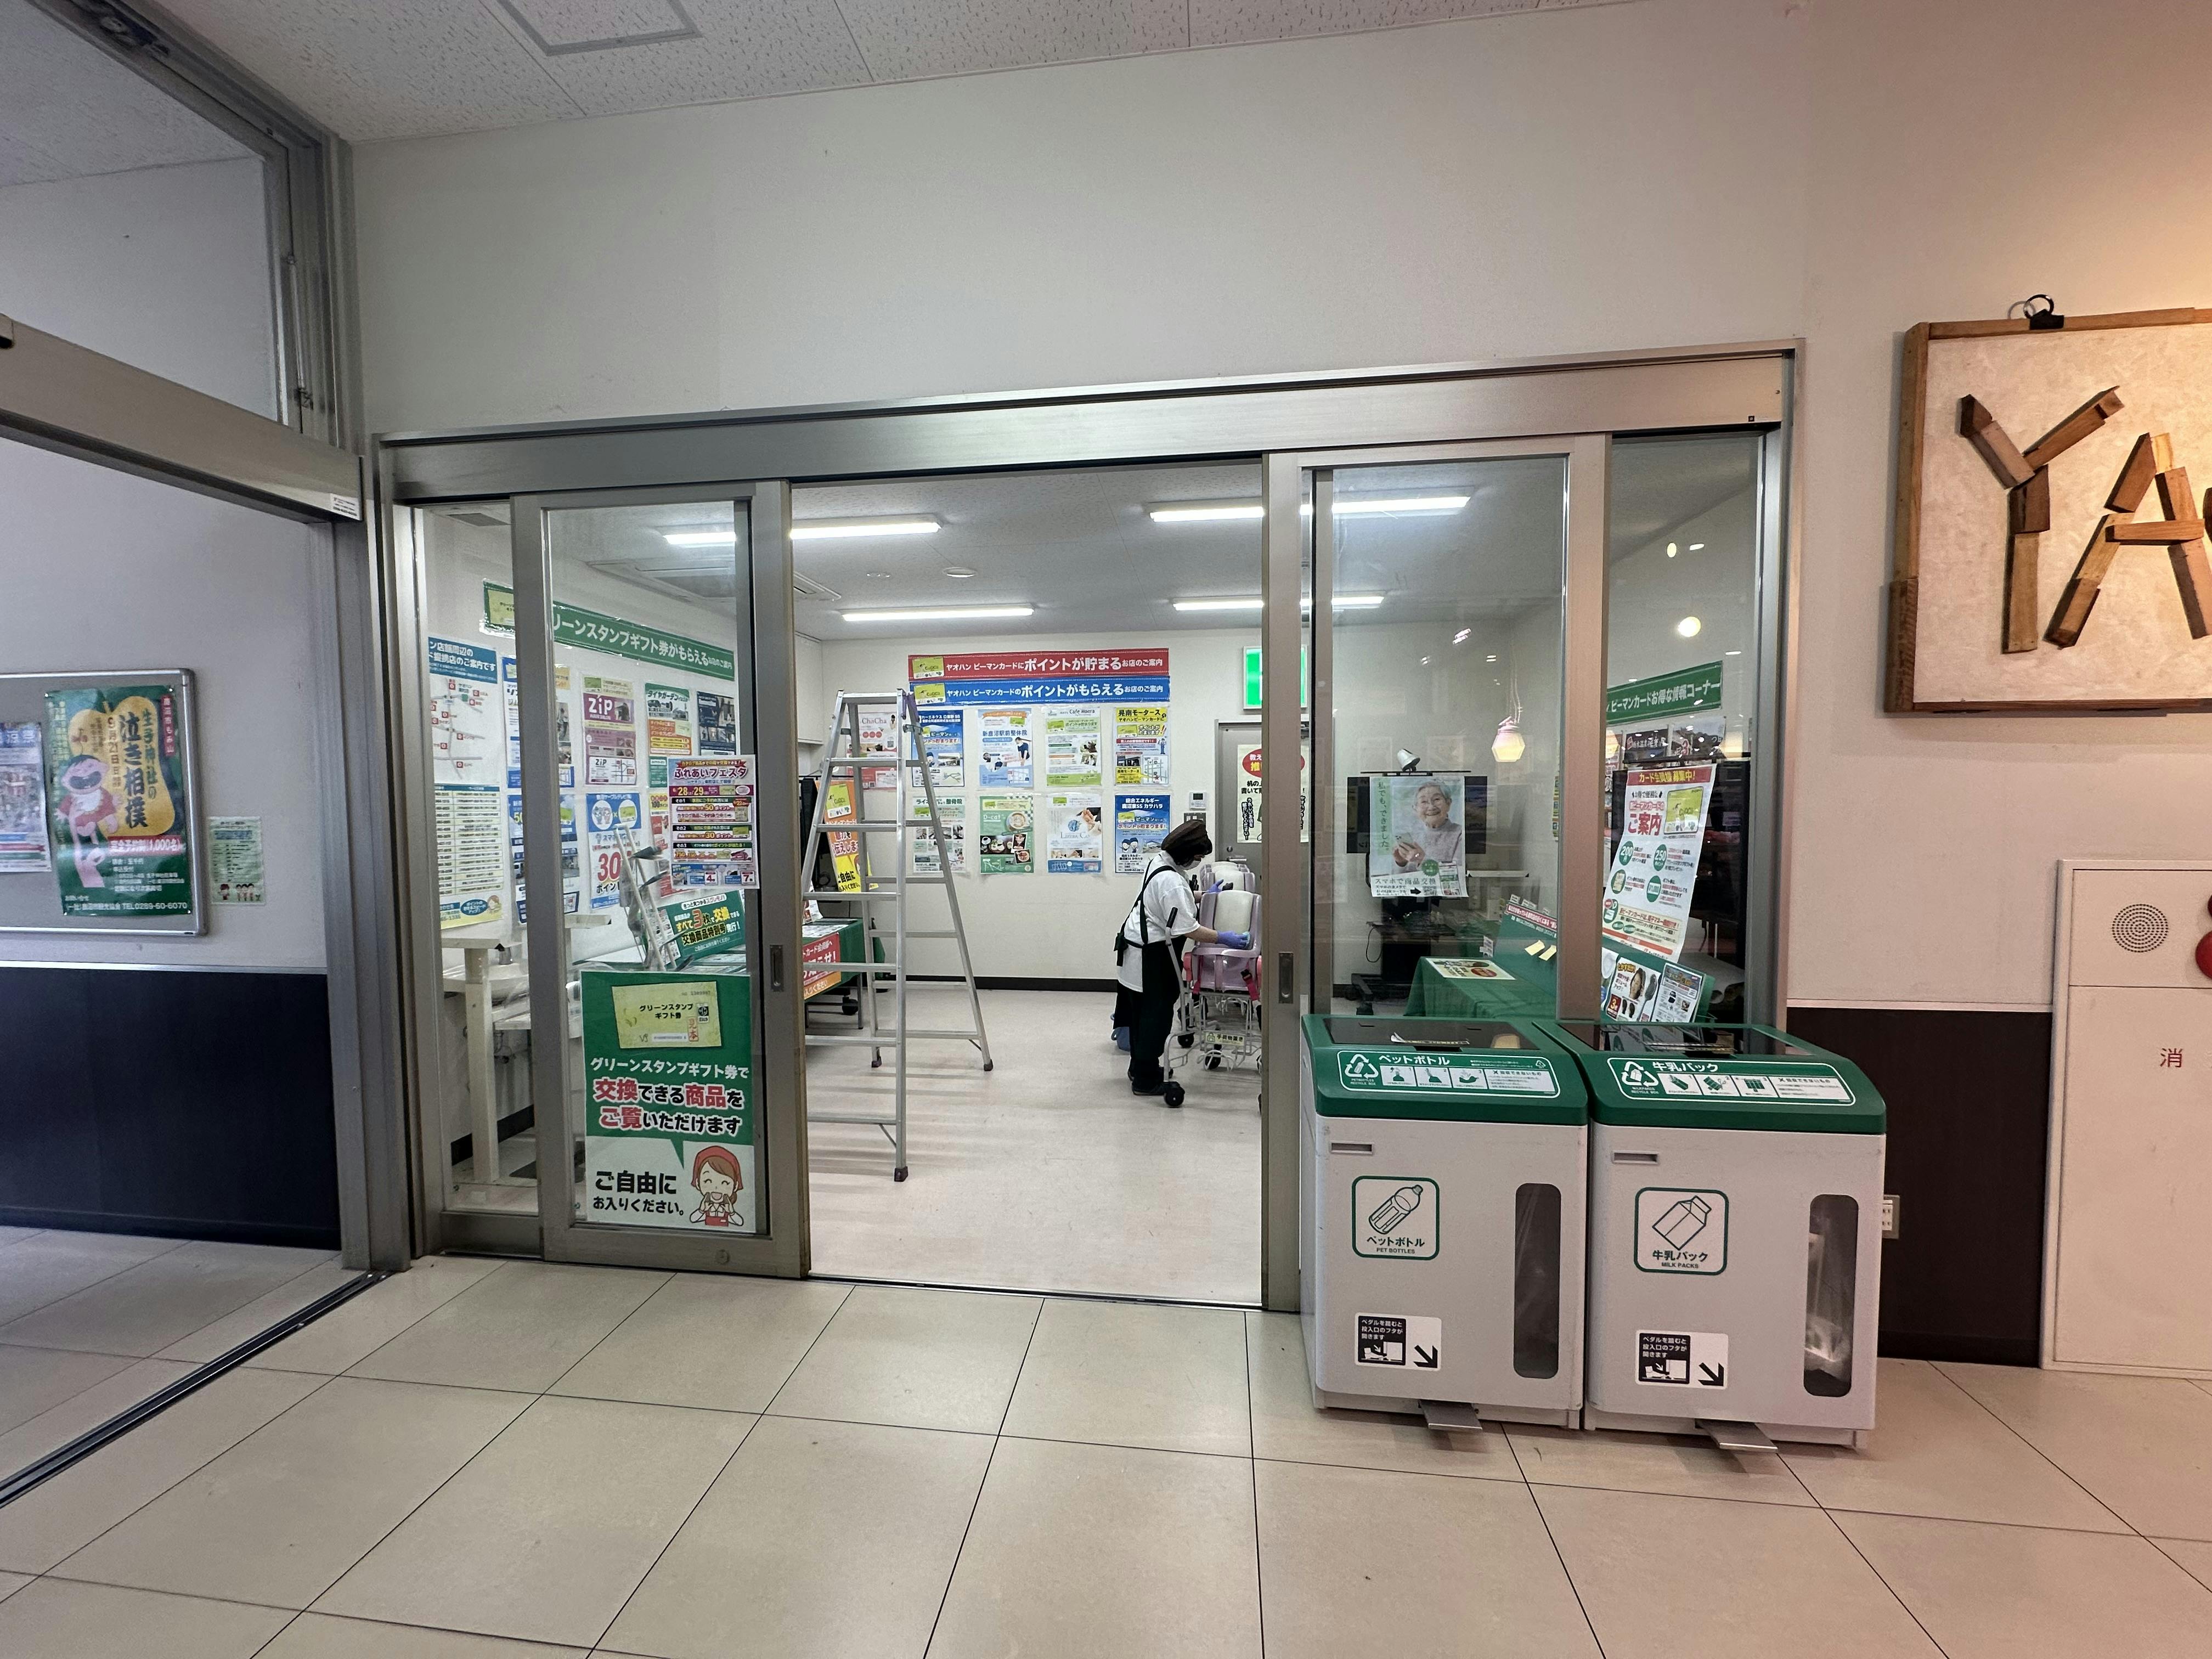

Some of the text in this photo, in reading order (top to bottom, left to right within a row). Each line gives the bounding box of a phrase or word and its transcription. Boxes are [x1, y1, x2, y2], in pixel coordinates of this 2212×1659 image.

[1956, 386, 2212, 653] YA
[674, 768, 748, 780] ふれあいフェスタ
[1628, 811, 1663, 836] ご案内
[1620, 847, 1633, 856] 200
[1655, 850, 1667, 861] 250
[639, 1003, 693, 1012] グリーンスタンプ
[1379, 1054, 1450, 1065] ペットボトル
[590, 1058, 749, 1080] グリーンスタンプギフト券で
[1652, 1062, 1718, 1072] 牛乳パック
[594, 1077, 744, 1109] 交換できる商品を
[600, 1105, 741, 1135] ご覧いただけます
[595, 1170, 677, 1195] ご自由に
[593, 1196, 684, 1216] お入りください。
[1367, 1236, 1425, 1248] ペットボトル
[1652, 1250, 1708, 1262] 牛乳パック
[1361, 1319, 1403, 1328] ペダルを踏むと
[1361, 1326, 1403, 1335] 投入口のフタが
[1643, 1336, 1687, 1345] ペダルを踏むと
[1643, 1343, 1688, 1352] 投入口のフタが
